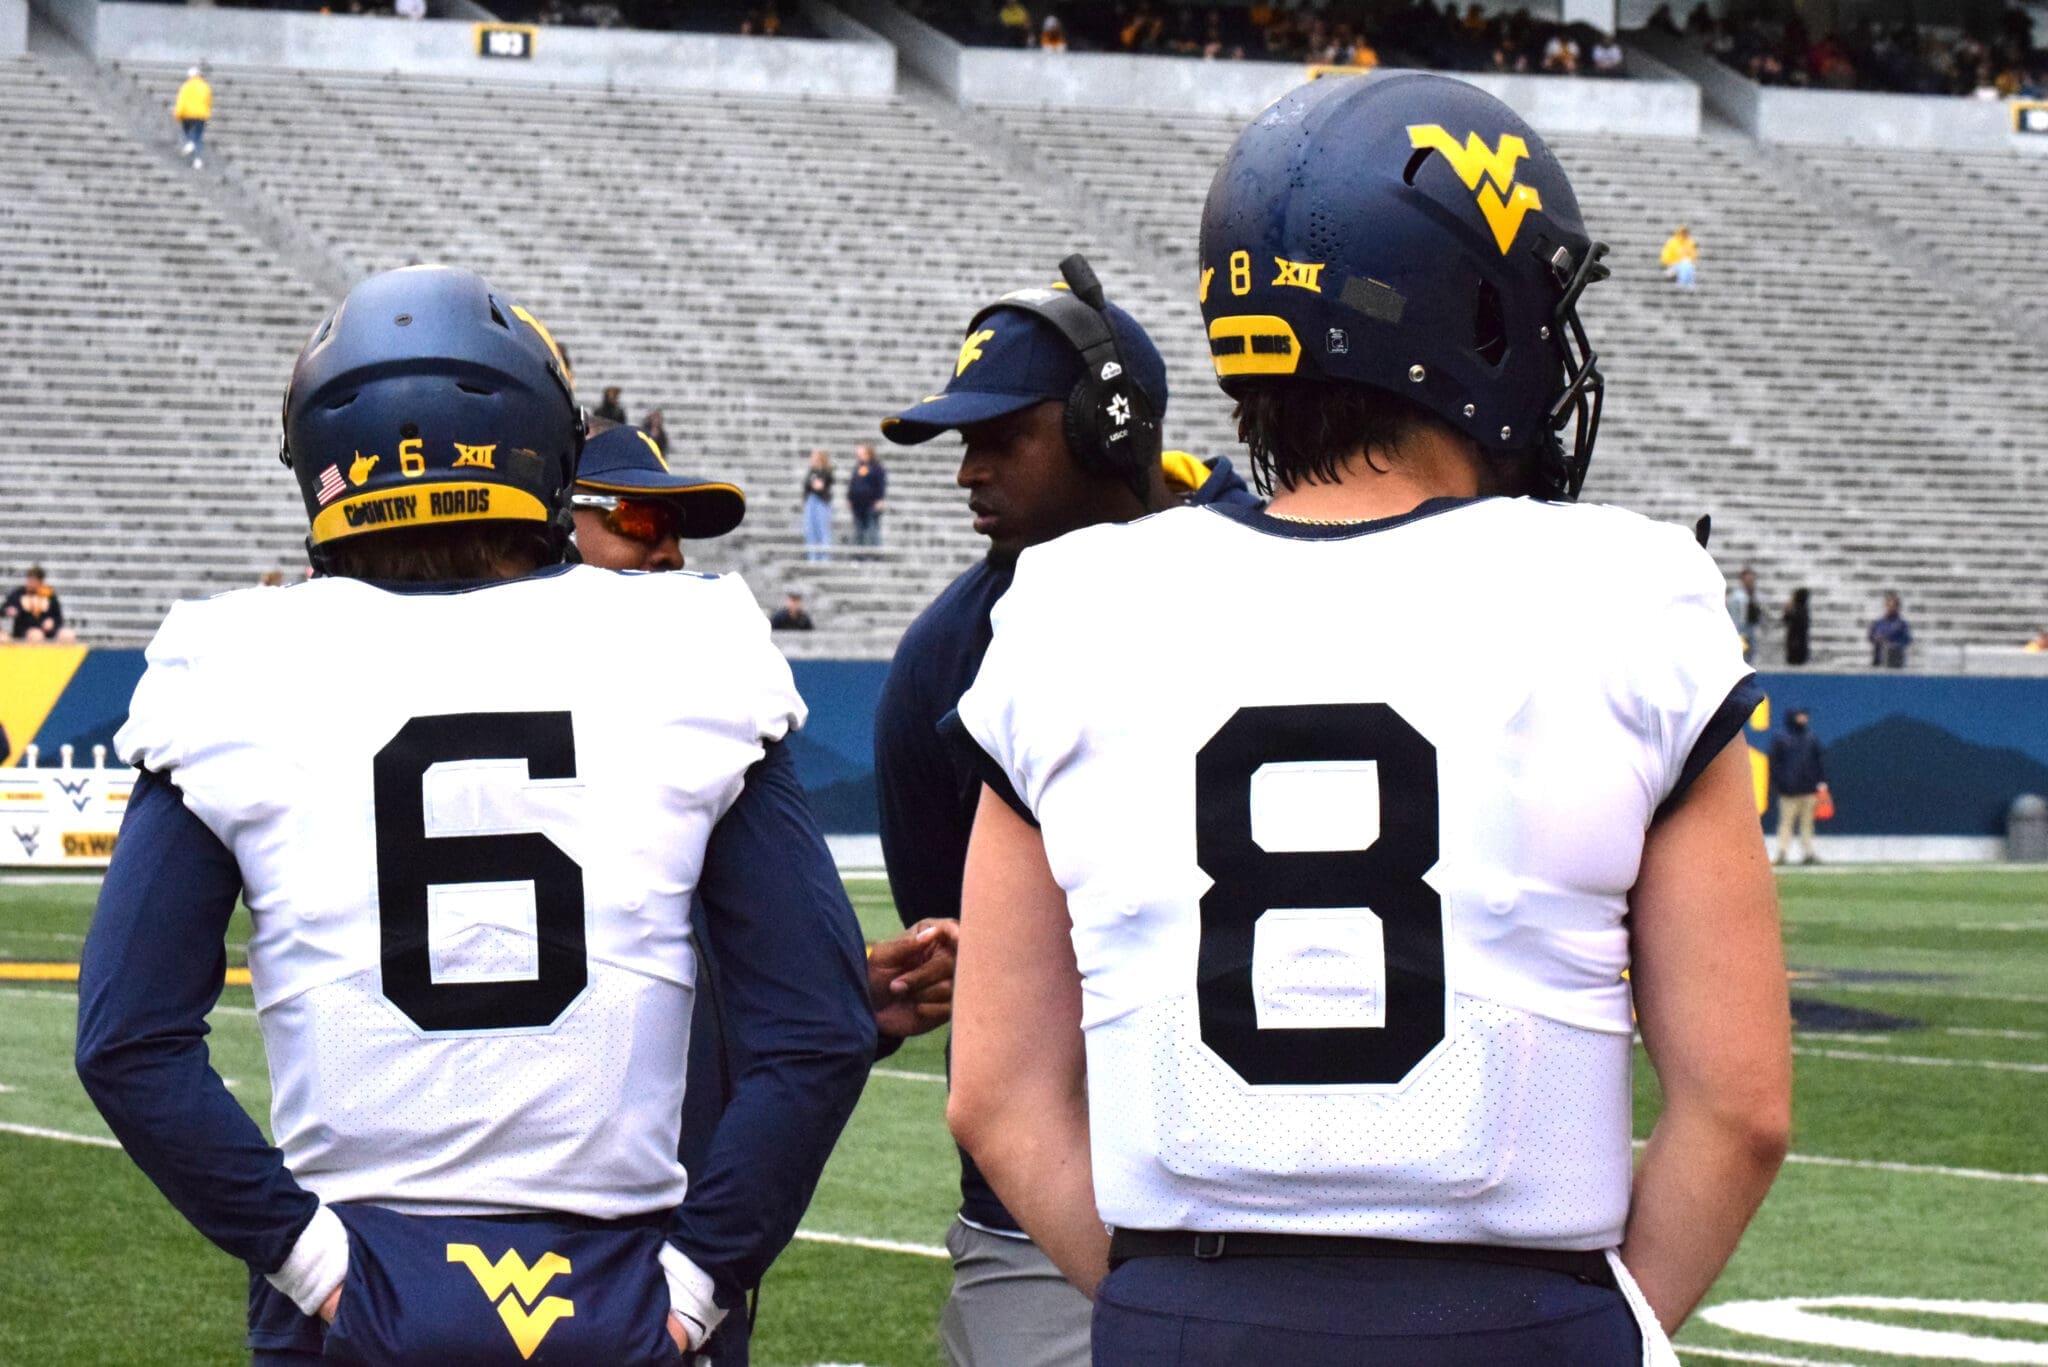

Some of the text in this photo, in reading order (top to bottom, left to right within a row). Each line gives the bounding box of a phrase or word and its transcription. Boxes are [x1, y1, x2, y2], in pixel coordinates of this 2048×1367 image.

[1230, 250, 1251, 296] 8
[399, 438, 426, 478] 6
[430, 488, 490, 517] ROADS
[374, 711, 587, 1031] 6
[1196, 703, 1445, 1085] 8
[447, 1243, 575, 1360] WV
